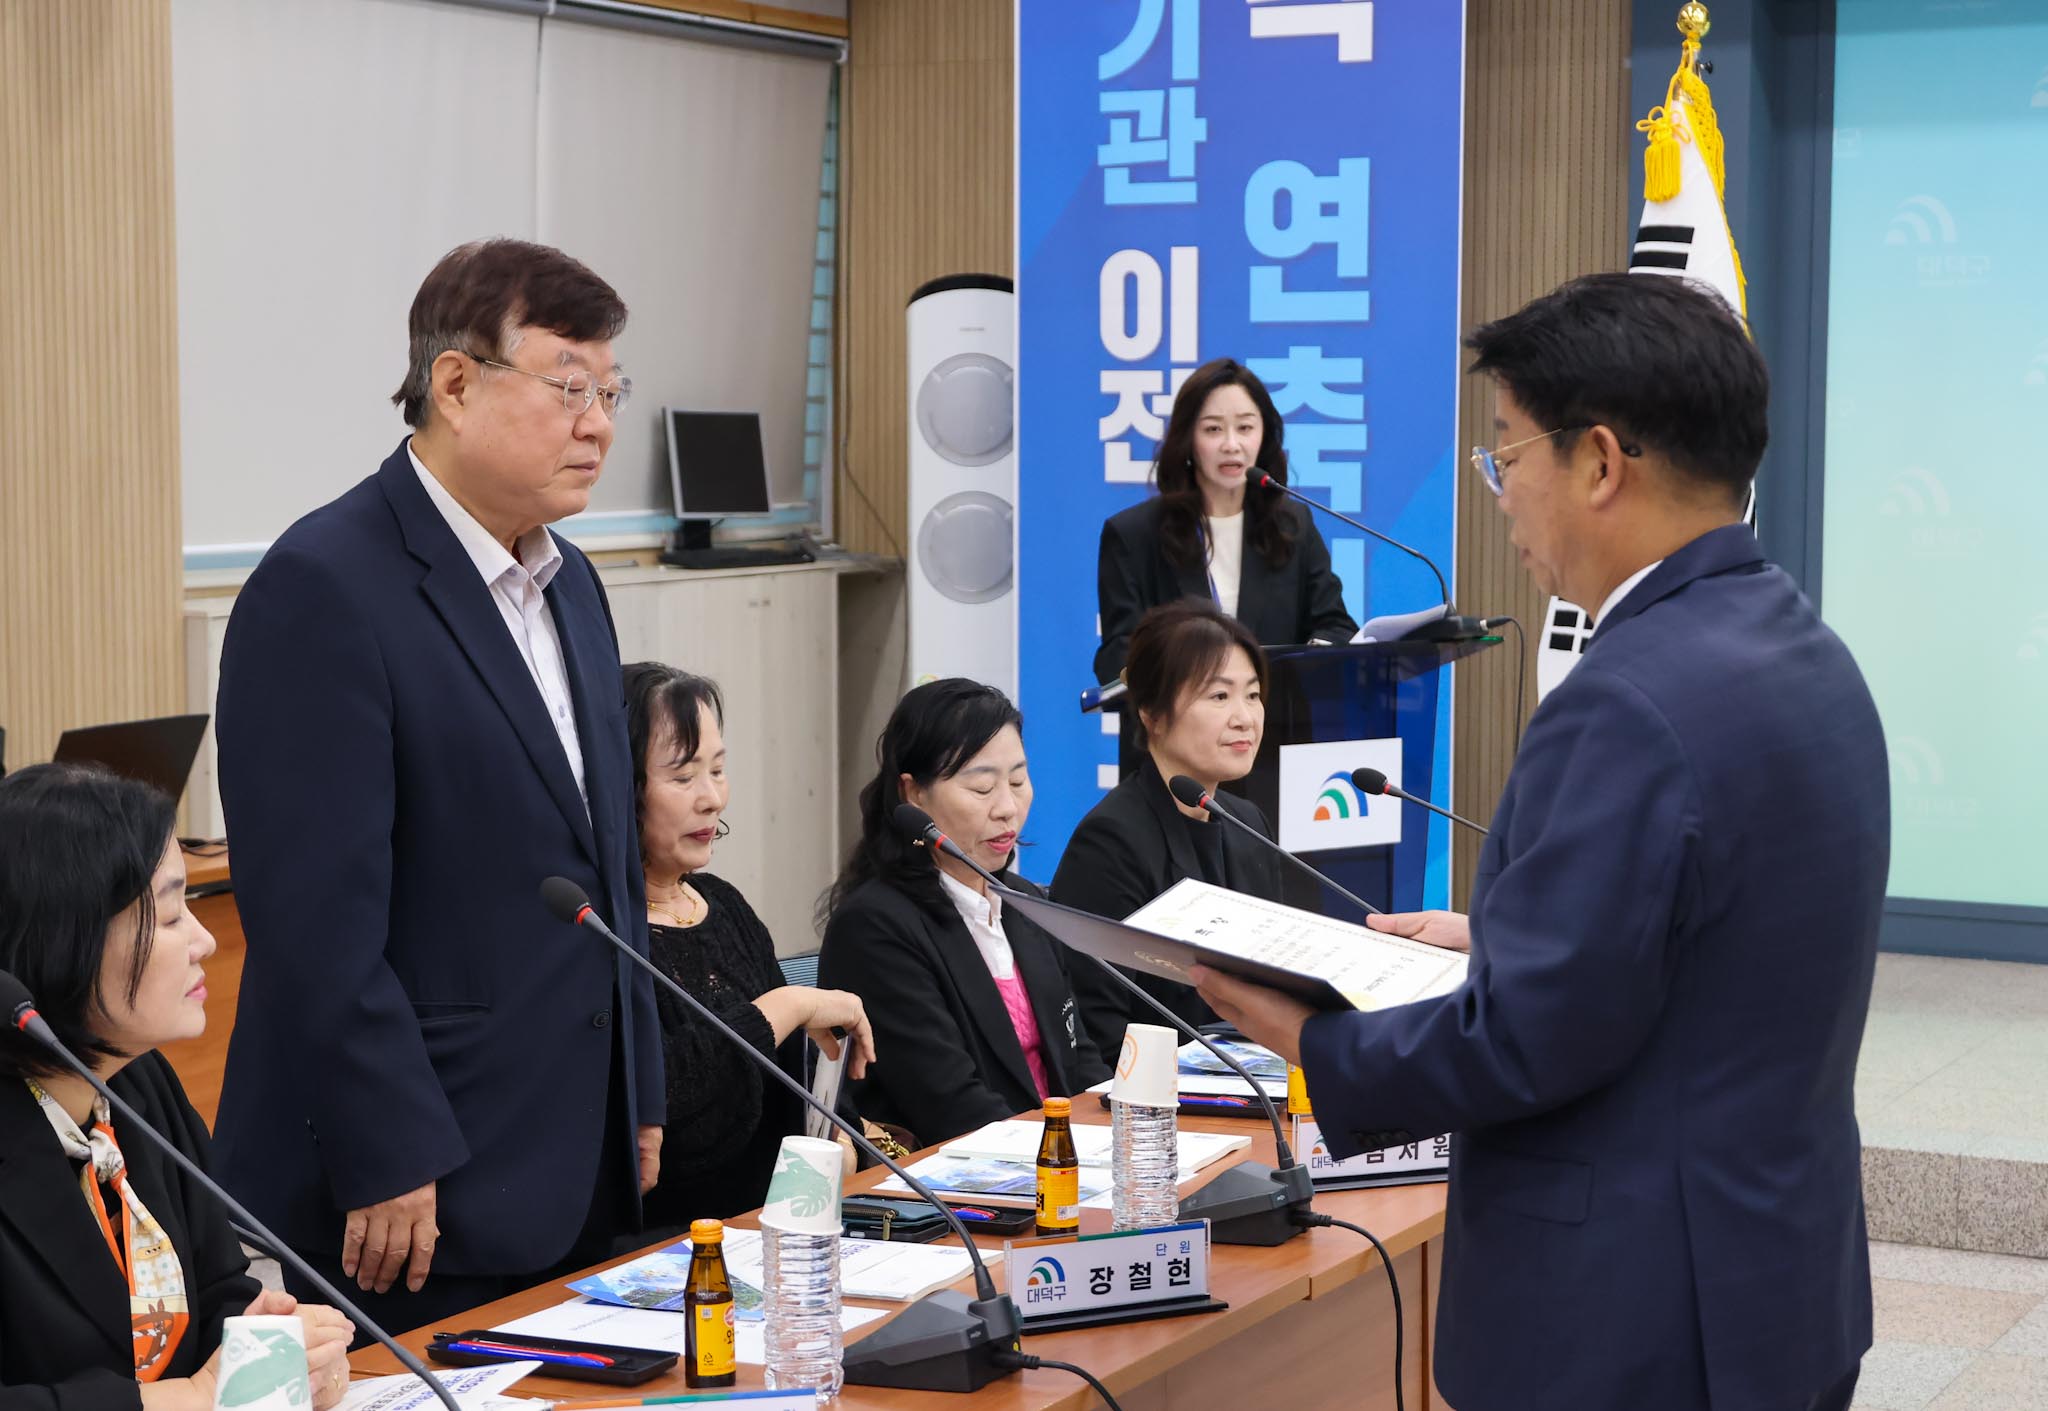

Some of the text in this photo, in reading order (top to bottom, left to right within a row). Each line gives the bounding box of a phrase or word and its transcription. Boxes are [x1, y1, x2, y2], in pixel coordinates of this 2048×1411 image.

[1099, 246, 1199, 485] 이전
[1155, 1239, 1191, 1257] 단원
[1089, 1256, 1191, 1296] 장철현
[1027, 1285, 1067, 1303] 대덕구
